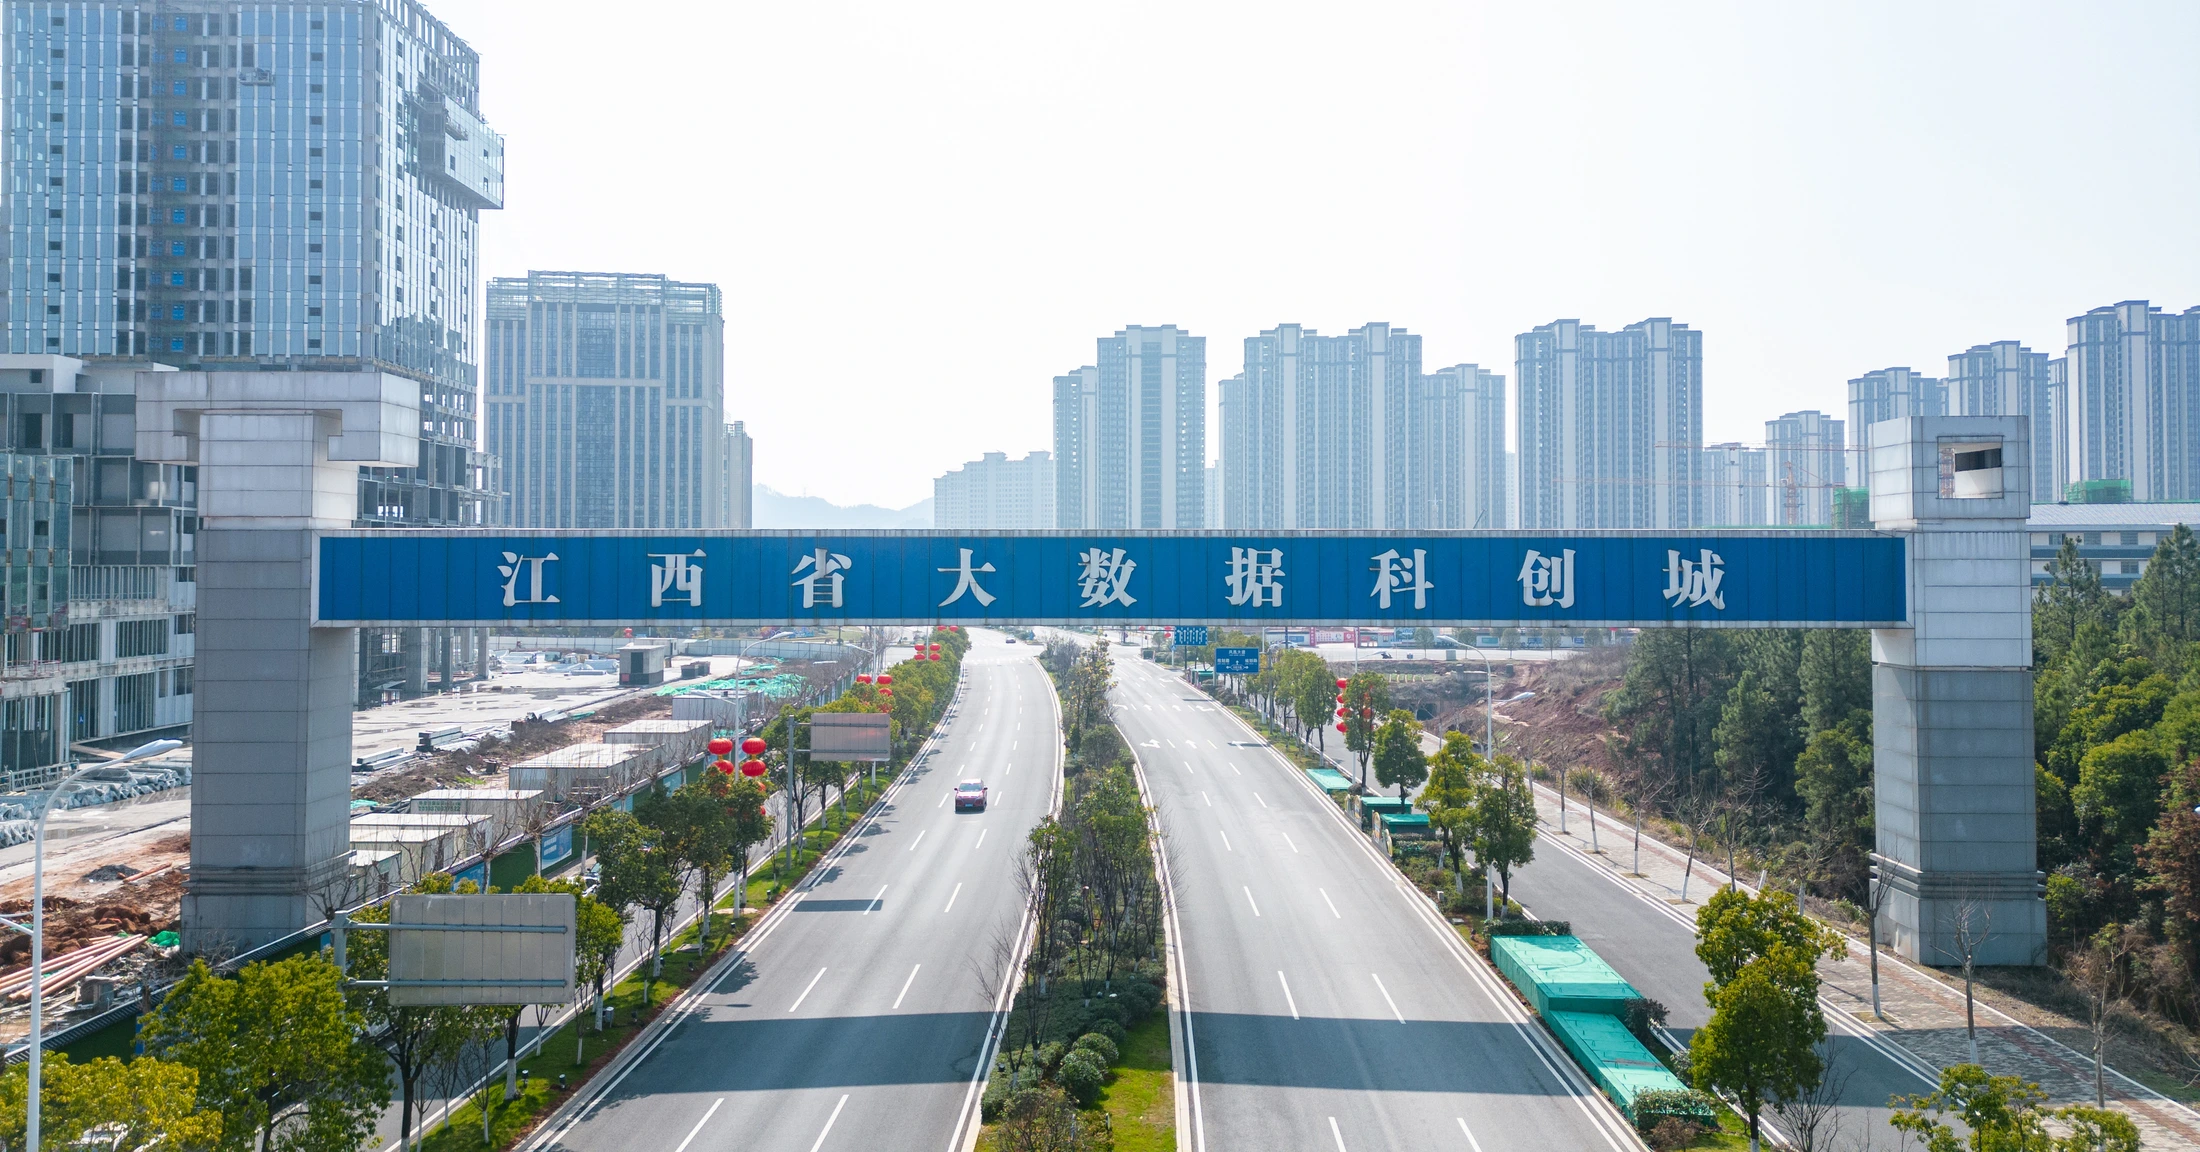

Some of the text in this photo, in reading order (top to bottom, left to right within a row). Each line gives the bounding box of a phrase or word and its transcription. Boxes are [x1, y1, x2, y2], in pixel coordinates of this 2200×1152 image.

[497, 547, 1726, 610] 江西省大数据科创城
